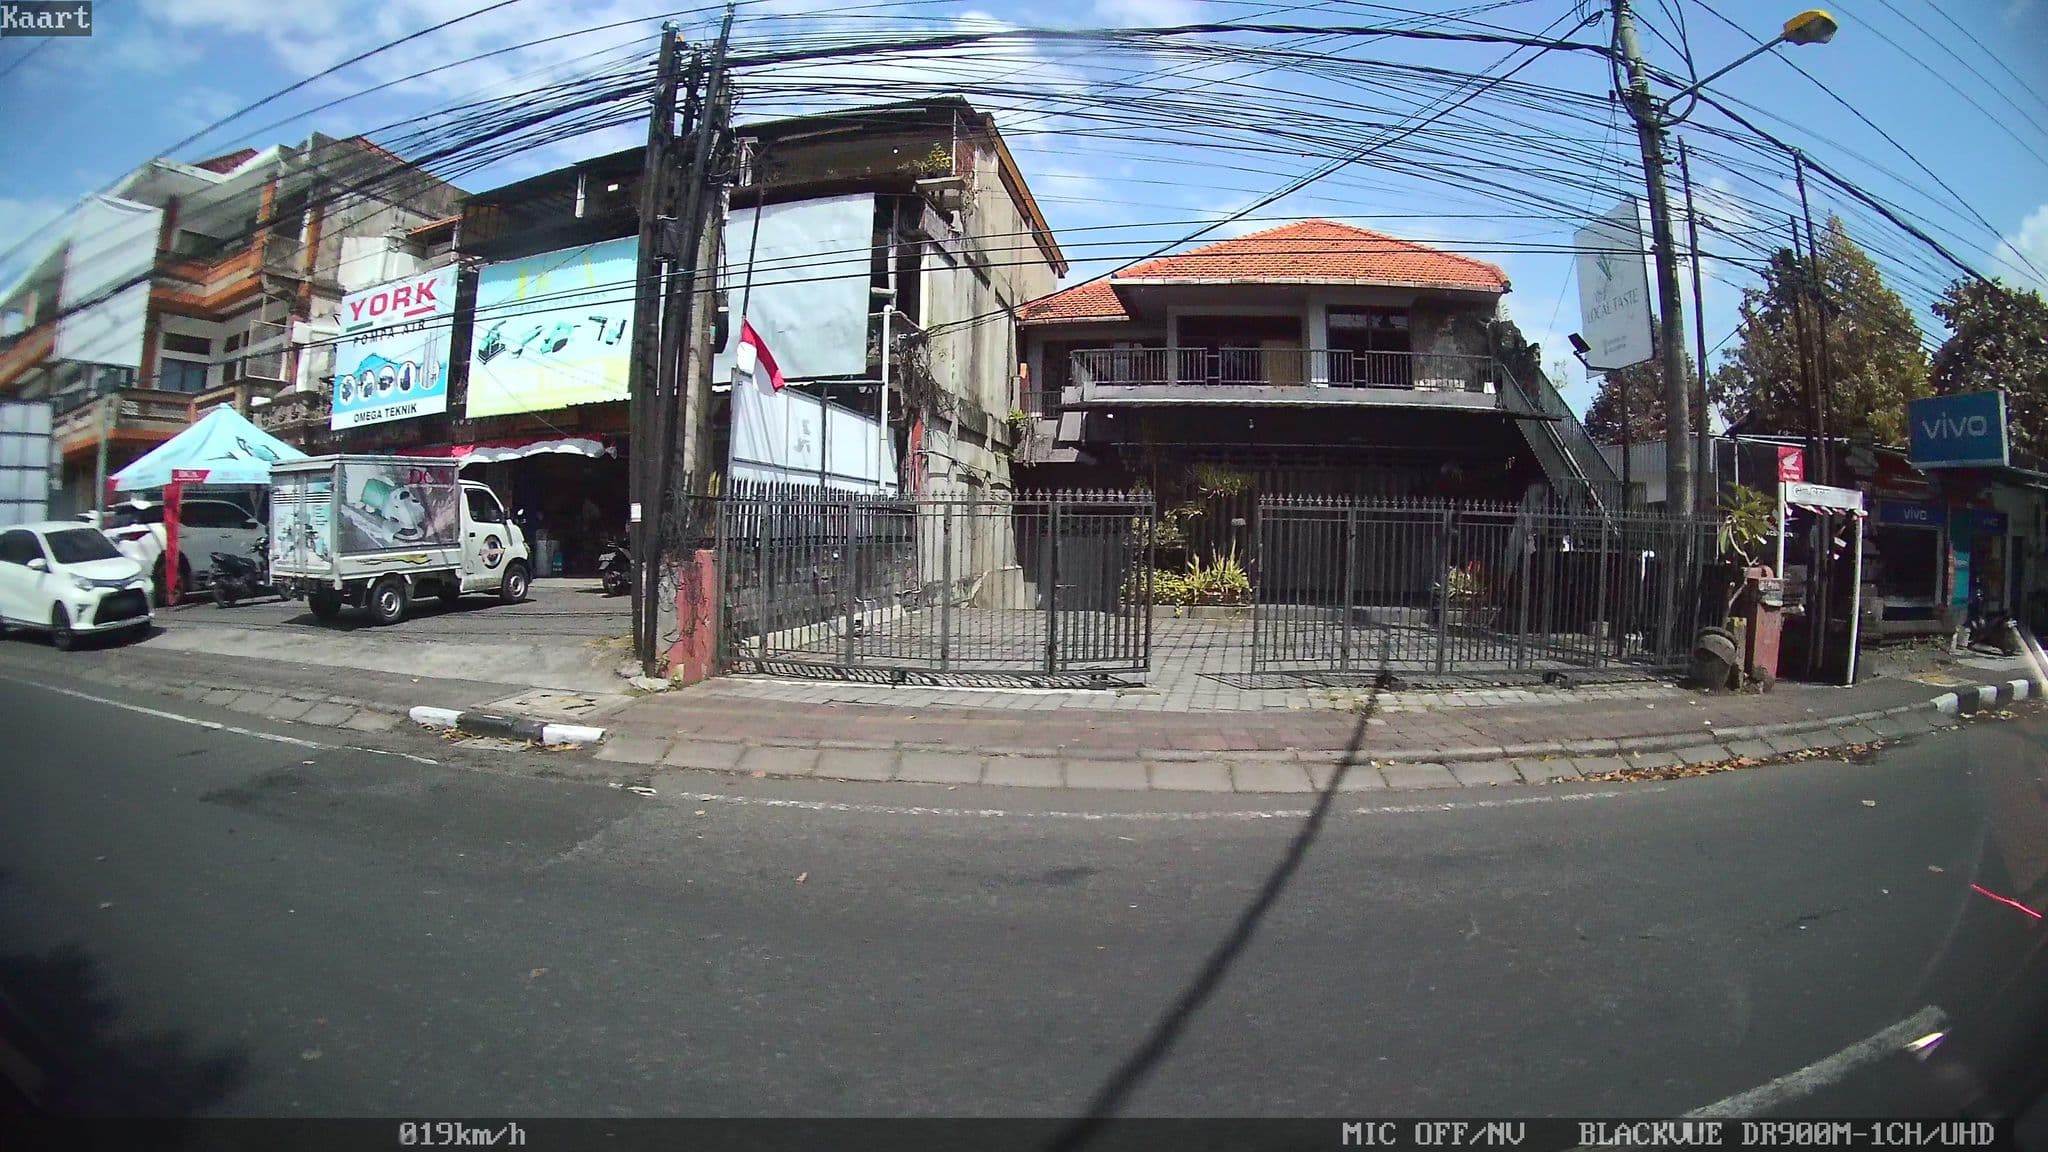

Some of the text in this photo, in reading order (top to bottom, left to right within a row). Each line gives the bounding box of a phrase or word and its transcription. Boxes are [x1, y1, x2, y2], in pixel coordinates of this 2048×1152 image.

[349, 278, 438, 321] YORK
[1587, 288, 1639, 324] LOCAL TASTE
[353, 403, 418, 423] OMEGA TEKNIK
[1922, 411, 1988, 440] vivo
[1903, 506, 1928, 520] vivo
